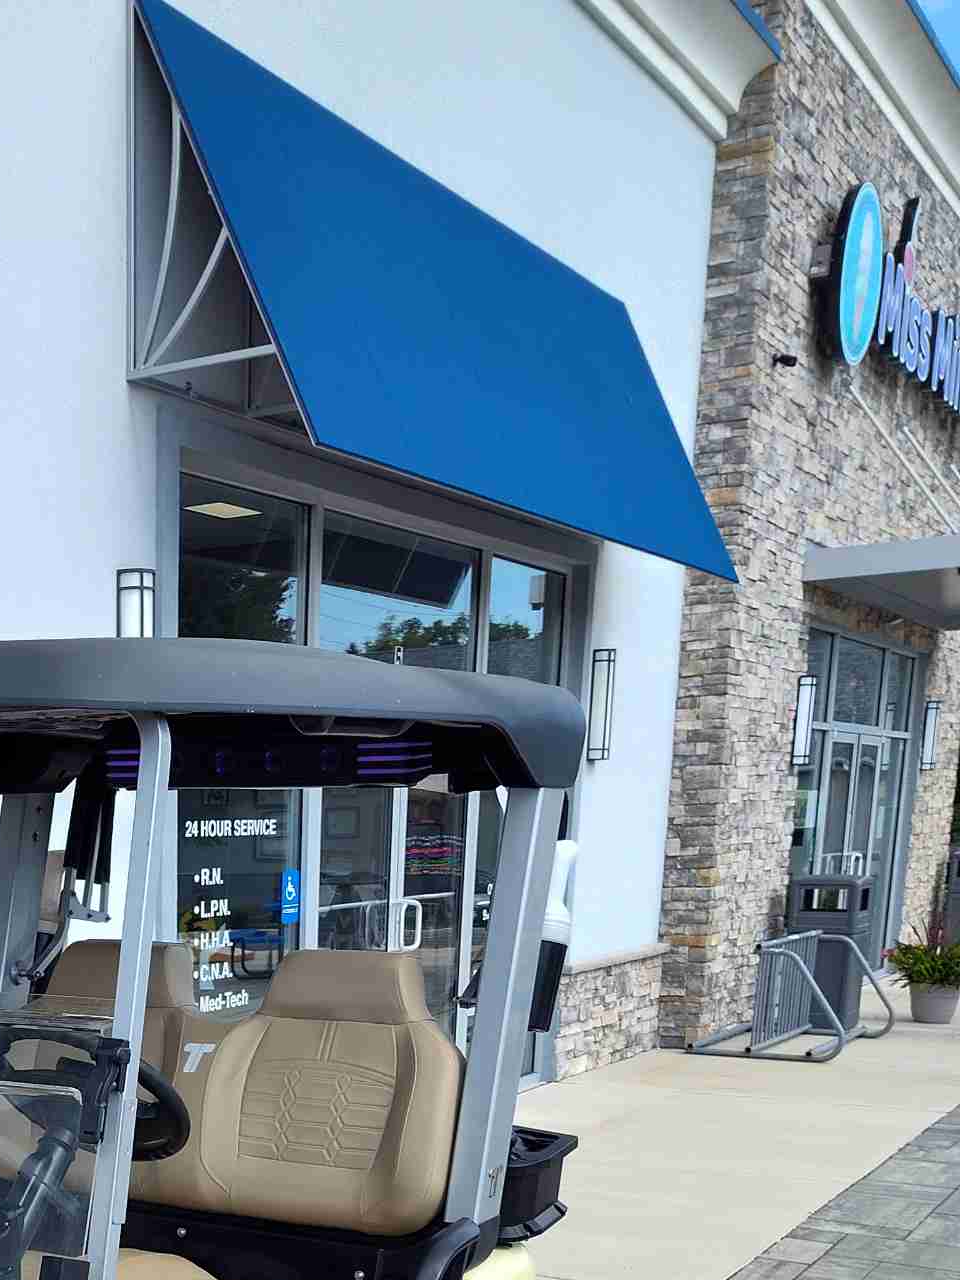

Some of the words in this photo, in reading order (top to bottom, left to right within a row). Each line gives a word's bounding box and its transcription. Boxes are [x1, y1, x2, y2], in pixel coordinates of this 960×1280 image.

[184, 821, 199, 838] 24
[200, 819, 232, 838] HOUR
[233, 818, 277, 836] SERVICE
[200, 867, 224, 886] R.N.
[200, 898, 231, 918] L.P.N.
[200, 931, 233, 951] H.H.A.
[199, 962, 233, 982] C.N.A.
[199, 989, 249, 1013] Med-Tech
